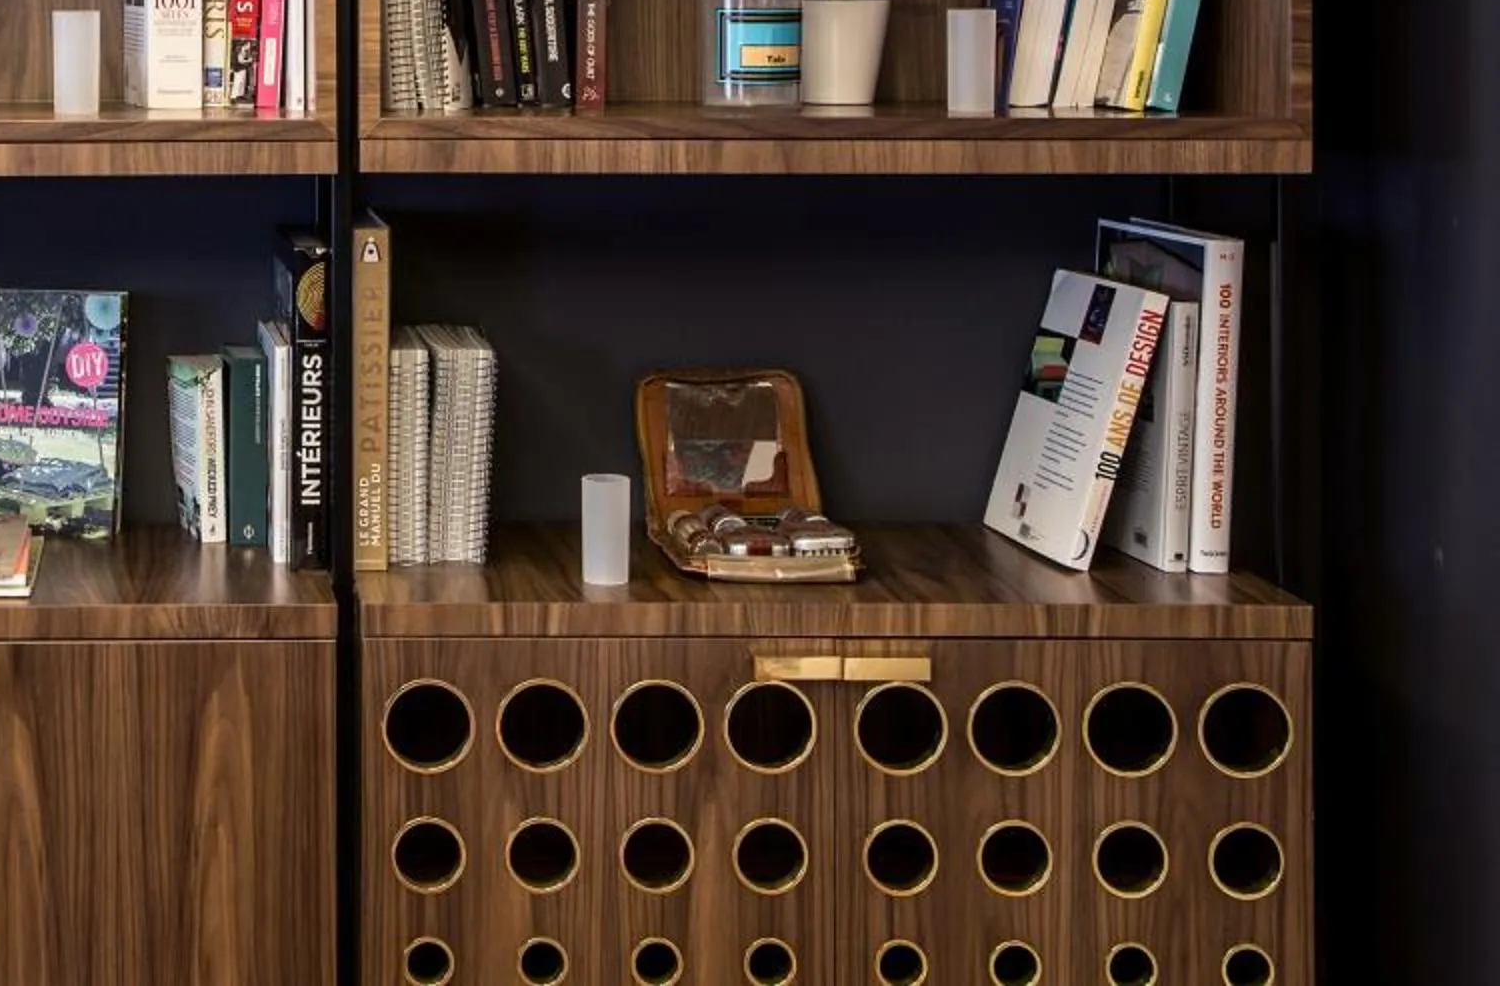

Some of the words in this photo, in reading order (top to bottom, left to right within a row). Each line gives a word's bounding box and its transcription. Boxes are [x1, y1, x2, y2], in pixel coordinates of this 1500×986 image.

[1218, 282, 1233, 309] 100
[1125, 308, 1164, 378] DESIGN
[1215, 317, 1232, 384] INTERIORS
[71, 352, 102, 379] DIY
[1117, 381, 1142, 409] DE
[296, 354, 323, 506] INTÉRIEURS
[1106, 409, 1134, 449] ANS
[1213, 388, 1230, 448] AROUND
[371, 462, 382, 483] DU
[1094, 451, 1122, 482] 100
[1212, 449, 1225, 476] THE
[359, 477, 370, 527] GRAND
[371, 488, 382, 547] MANUEL
[1209, 480, 1224, 529] WORLD
[360, 531, 370, 547] LE
